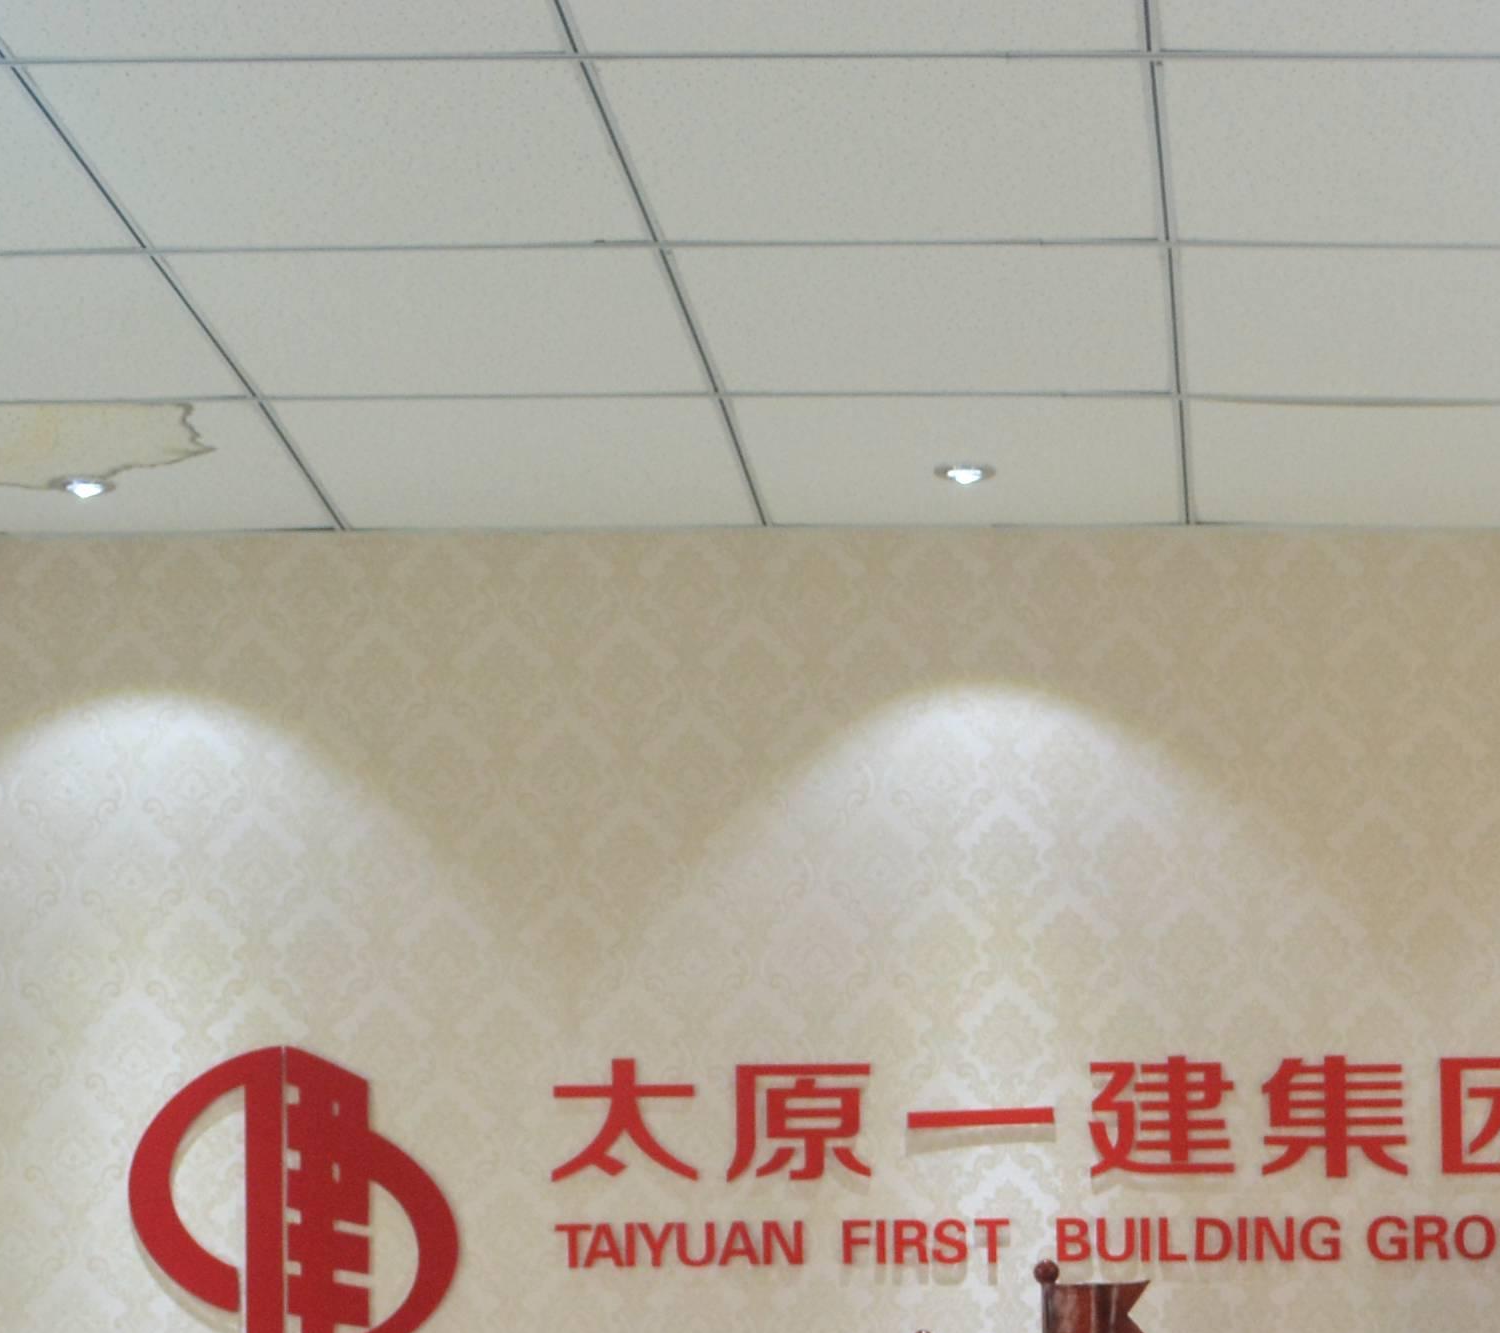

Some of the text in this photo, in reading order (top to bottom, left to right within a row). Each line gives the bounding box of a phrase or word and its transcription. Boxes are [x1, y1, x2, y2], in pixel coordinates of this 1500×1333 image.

[555, 1222, 804, 1269] TAIYUAN
[842, 1220, 1010, 1267] FIRST
[1057, 1217, 1342, 1264] BUILDING
